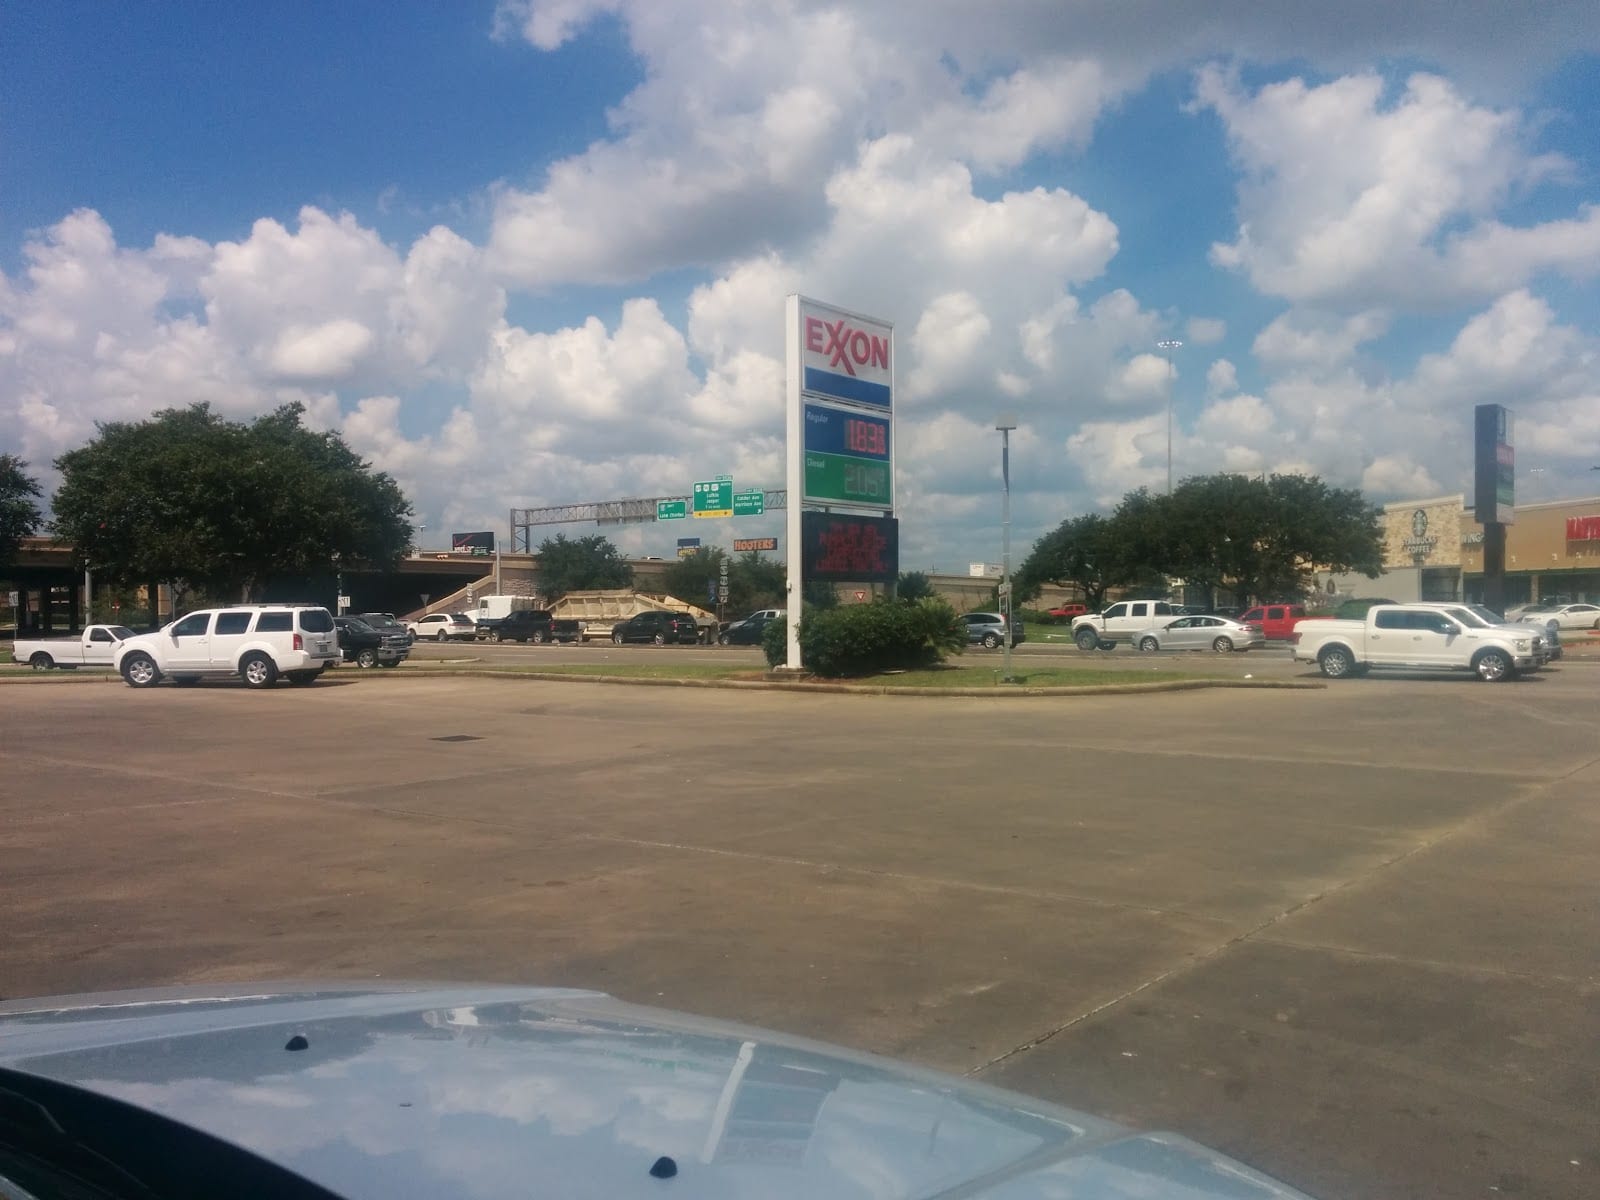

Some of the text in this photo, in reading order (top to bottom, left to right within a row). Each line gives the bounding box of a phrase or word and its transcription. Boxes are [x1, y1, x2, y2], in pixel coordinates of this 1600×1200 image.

[806, 316, 888, 377] EXXON
[806, 411, 829, 423] Regular
[807, 458, 825, 468] Diesel
[734, 539, 774, 551] HOOTERS
[1403, 534, 1438, 545] STARBUCKS
[1407, 545, 1430, 554] COFFEE
